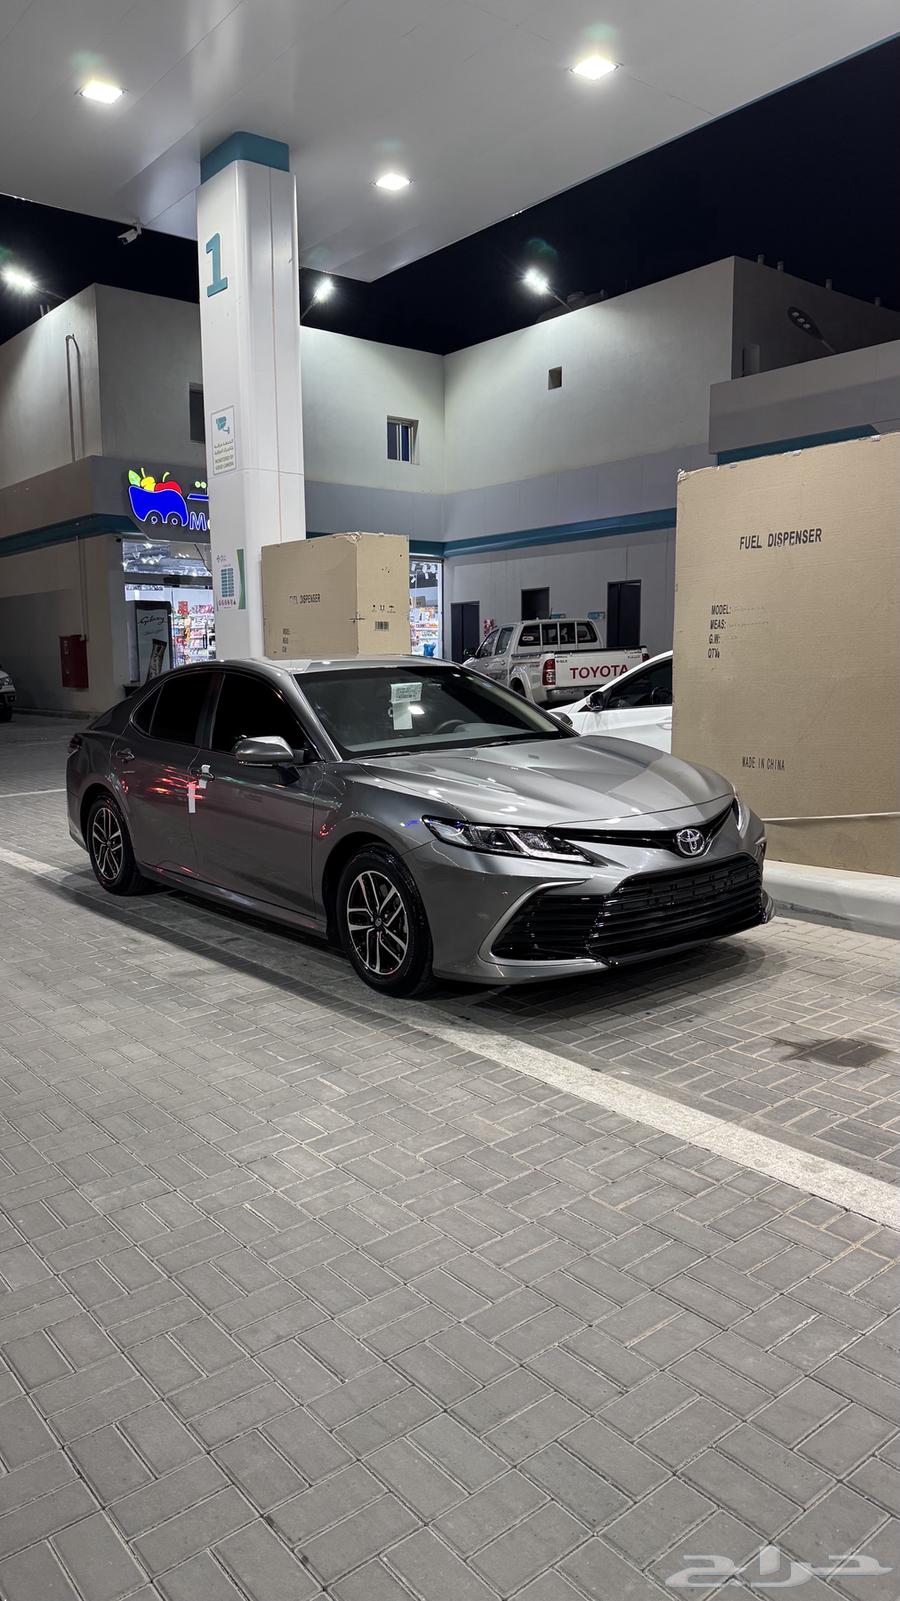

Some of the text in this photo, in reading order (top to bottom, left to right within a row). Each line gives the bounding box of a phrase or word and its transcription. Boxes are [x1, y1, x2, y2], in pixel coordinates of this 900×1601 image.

[206, 232, 229, 298] 1
[740, 528, 822, 550] FUEL DISPENSER
[711, 604, 732, 615] MODEL:
[710, 619, 727, 630] MEAS:
[569, 664, 629, 680] TOYOTA
[742, 756, 785, 771] MADE IN CHINA
